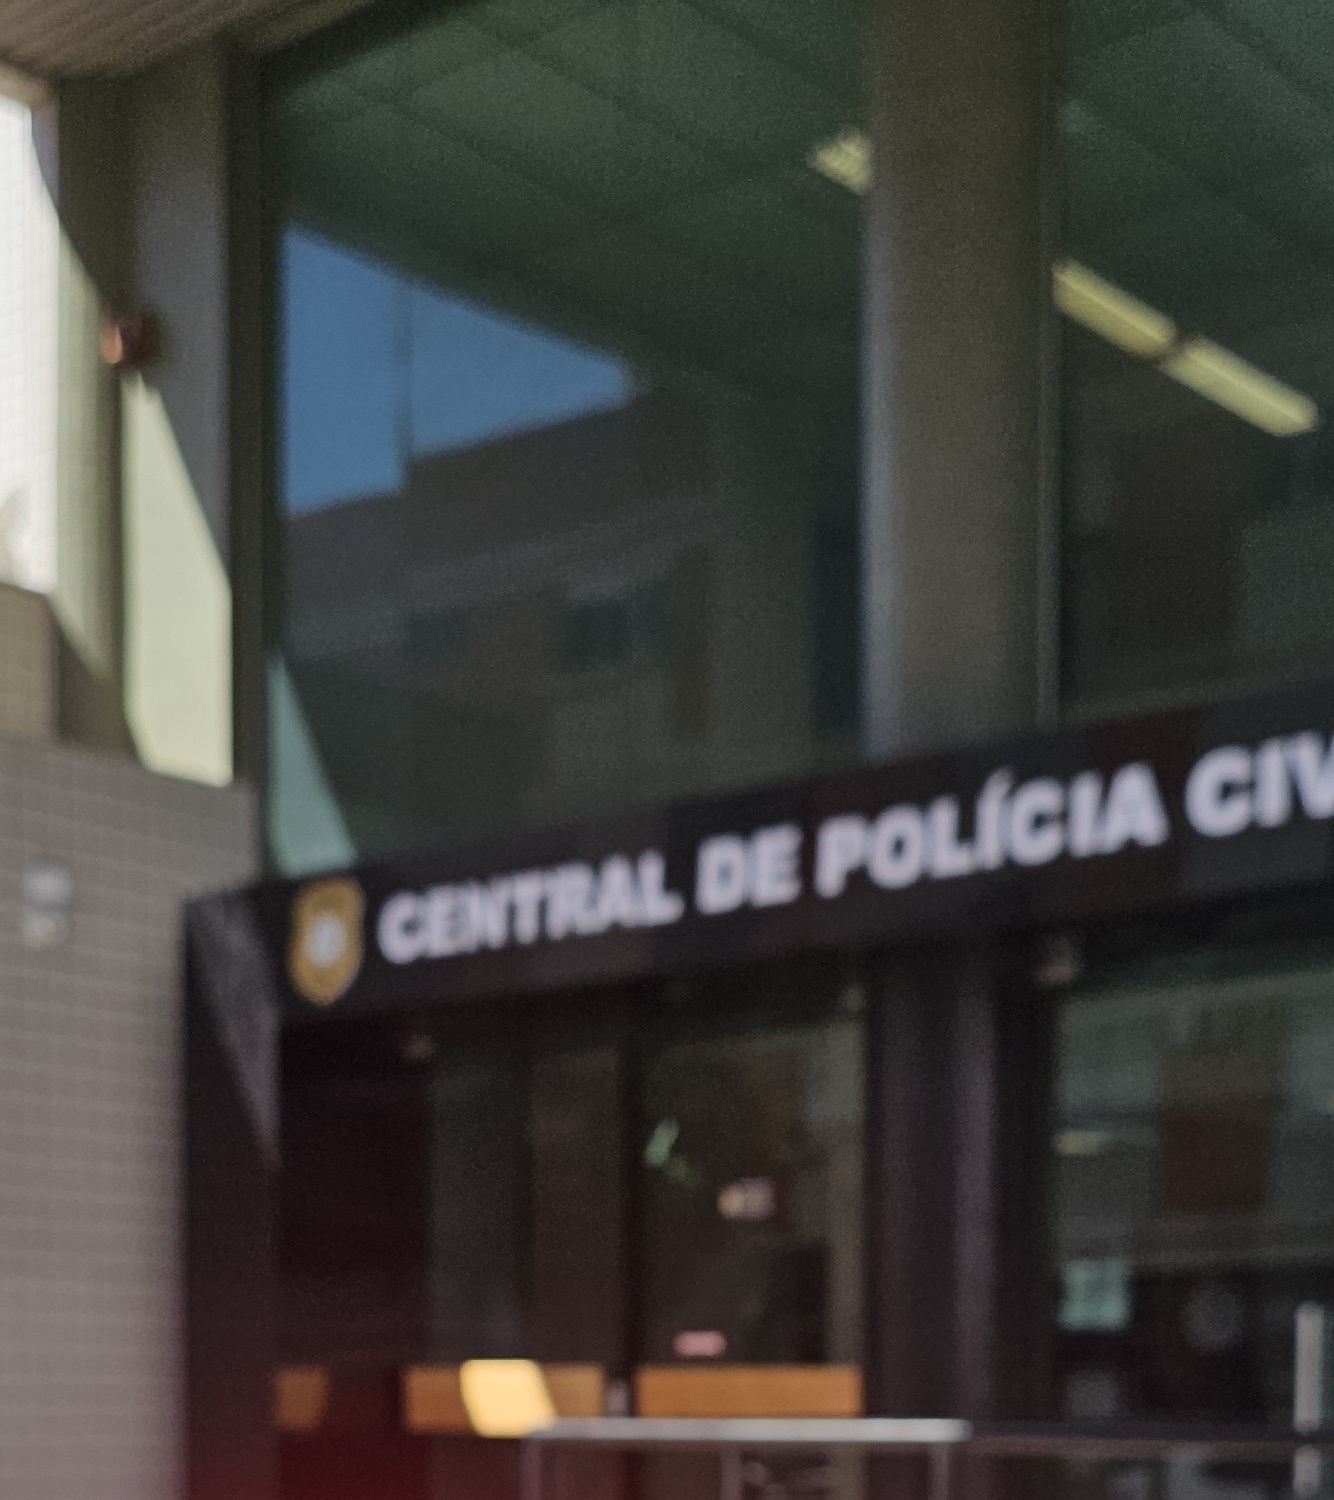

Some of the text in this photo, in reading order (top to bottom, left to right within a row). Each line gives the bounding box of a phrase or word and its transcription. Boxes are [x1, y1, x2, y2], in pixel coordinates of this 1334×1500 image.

[378, 850, 683, 963] CENTRAL
[696, 822, 800, 915] DE
[814, 763, 1167, 897] POLÍCIA
